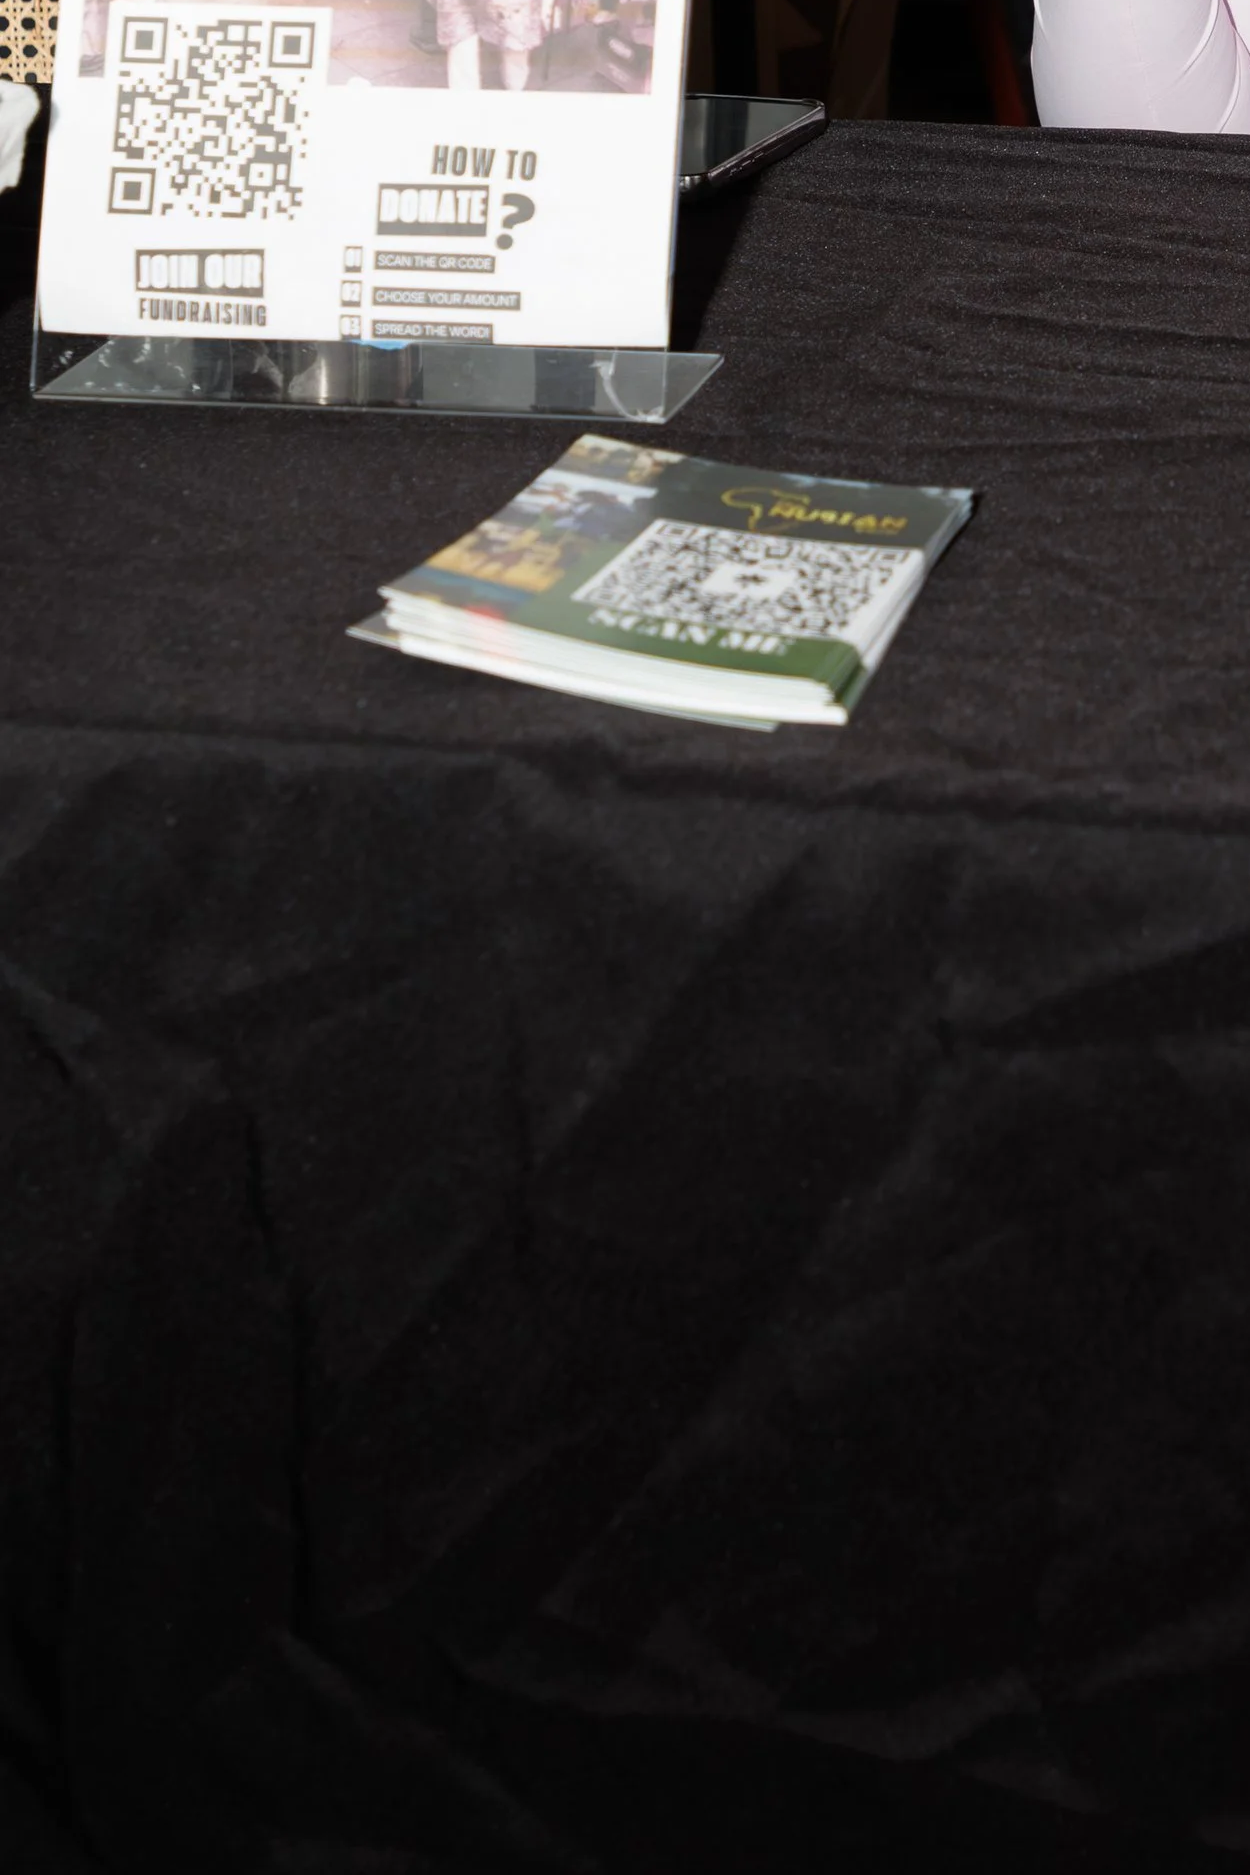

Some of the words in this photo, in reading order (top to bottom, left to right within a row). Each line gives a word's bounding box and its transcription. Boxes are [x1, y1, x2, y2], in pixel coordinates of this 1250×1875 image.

[431, 144, 496, 178] HOW
[506, 149, 538, 181] TO
[379, 188, 488, 224] DONATE
[495, 192, 536, 250] ?
[344, 247, 362, 267] 01
[377, 254, 413, 267] SCAN
[414, 255, 437, 268] THE
[438, 257, 457, 269] QR
[458, 258, 493, 271] CODE
[137, 253, 199, 289] JOIN
[204, 253, 262, 289] OUR
[341, 282, 361, 302] 02
[375, 290, 425, 304] CHOOSE
[427, 292, 462, 305] YOUR
[463, 293, 518, 307] AMOUNT
[138, 298, 267, 327] FUNDRAISING
[375, 323, 422, 336] SPREAD
[424, 324, 447, 337] THE
[449, 326, 490, 339] WORD!
[588, 609, 717, 646] SCAN
